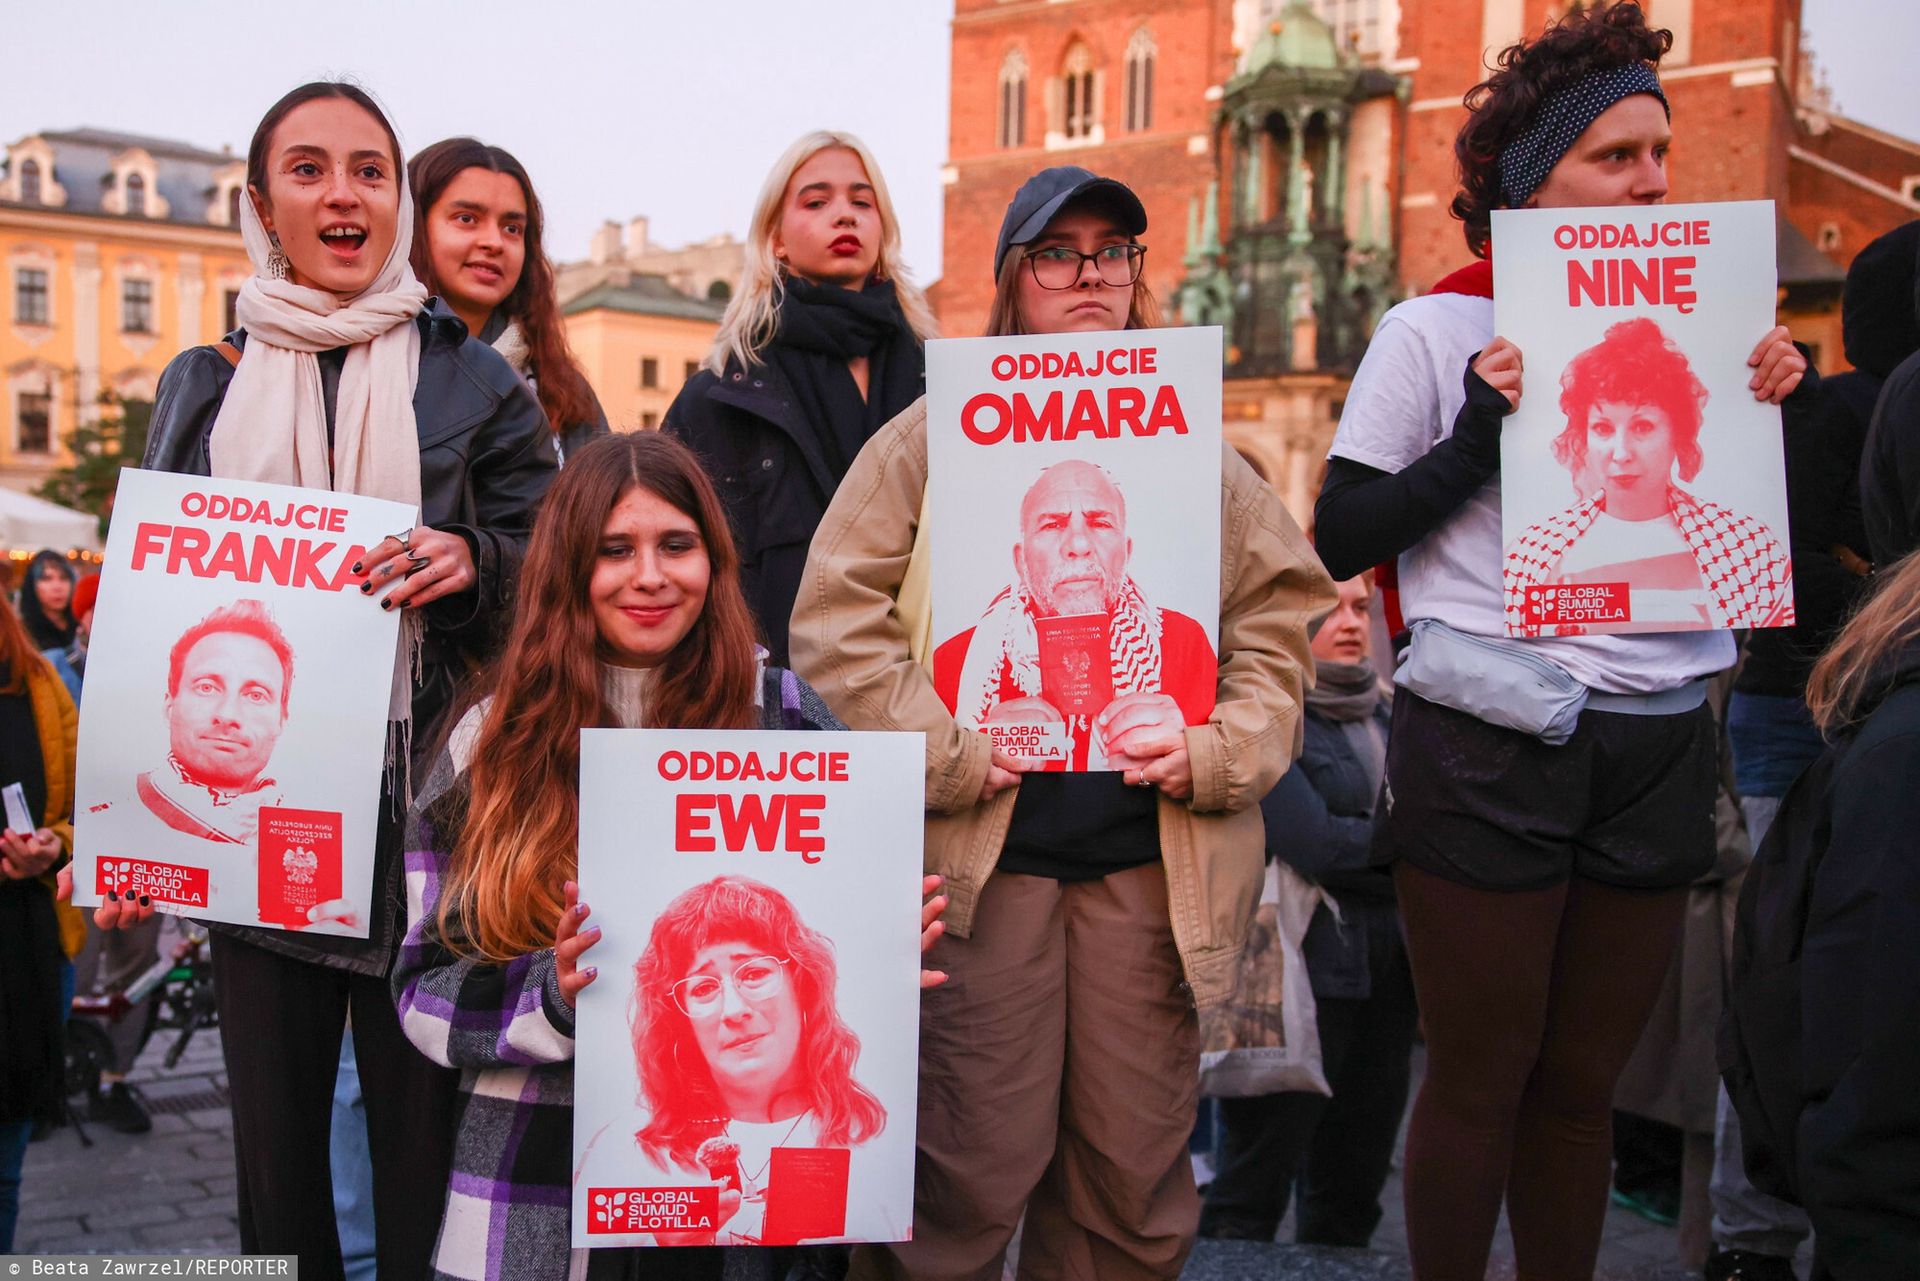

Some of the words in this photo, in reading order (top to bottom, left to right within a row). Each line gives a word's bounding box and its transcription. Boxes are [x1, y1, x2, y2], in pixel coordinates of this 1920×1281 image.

[1553, 220, 1711, 251] ODDAJCIE
[1567, 256, 1698, 315] NINĘ
[991, 347, 1158, 382] ODDAJCIE
[959, 384, 1189, 447] OMARA
[180, 492, 349, 533] ODDAJCIE
[130, 522, 368, 592] FRANKA
[1557, 587, 1614, 599] GLOBAL
[1557, 598, 1605, 609] SUMUD
[1557, 608, 1625, 620] FLOTILLA
[990, 726, 1049, 737] GLOBAL
[991, 736, 1040, 747] SUMUD
[999, 747, 1060, 757] OTILLA
[656, 750, 850, 783] ODDAJCIE
[674, 793, 827, 865] EWĘ
[132, 863, 193, 881] GLOBAL
[132, 873, 183, 889] SUMUD
[628, 1191, 700, 1204] GLOBAL
[628, 1204, 688, 1216] SUMUD
[627, 1216, 711, 1229] FLOTILLA
